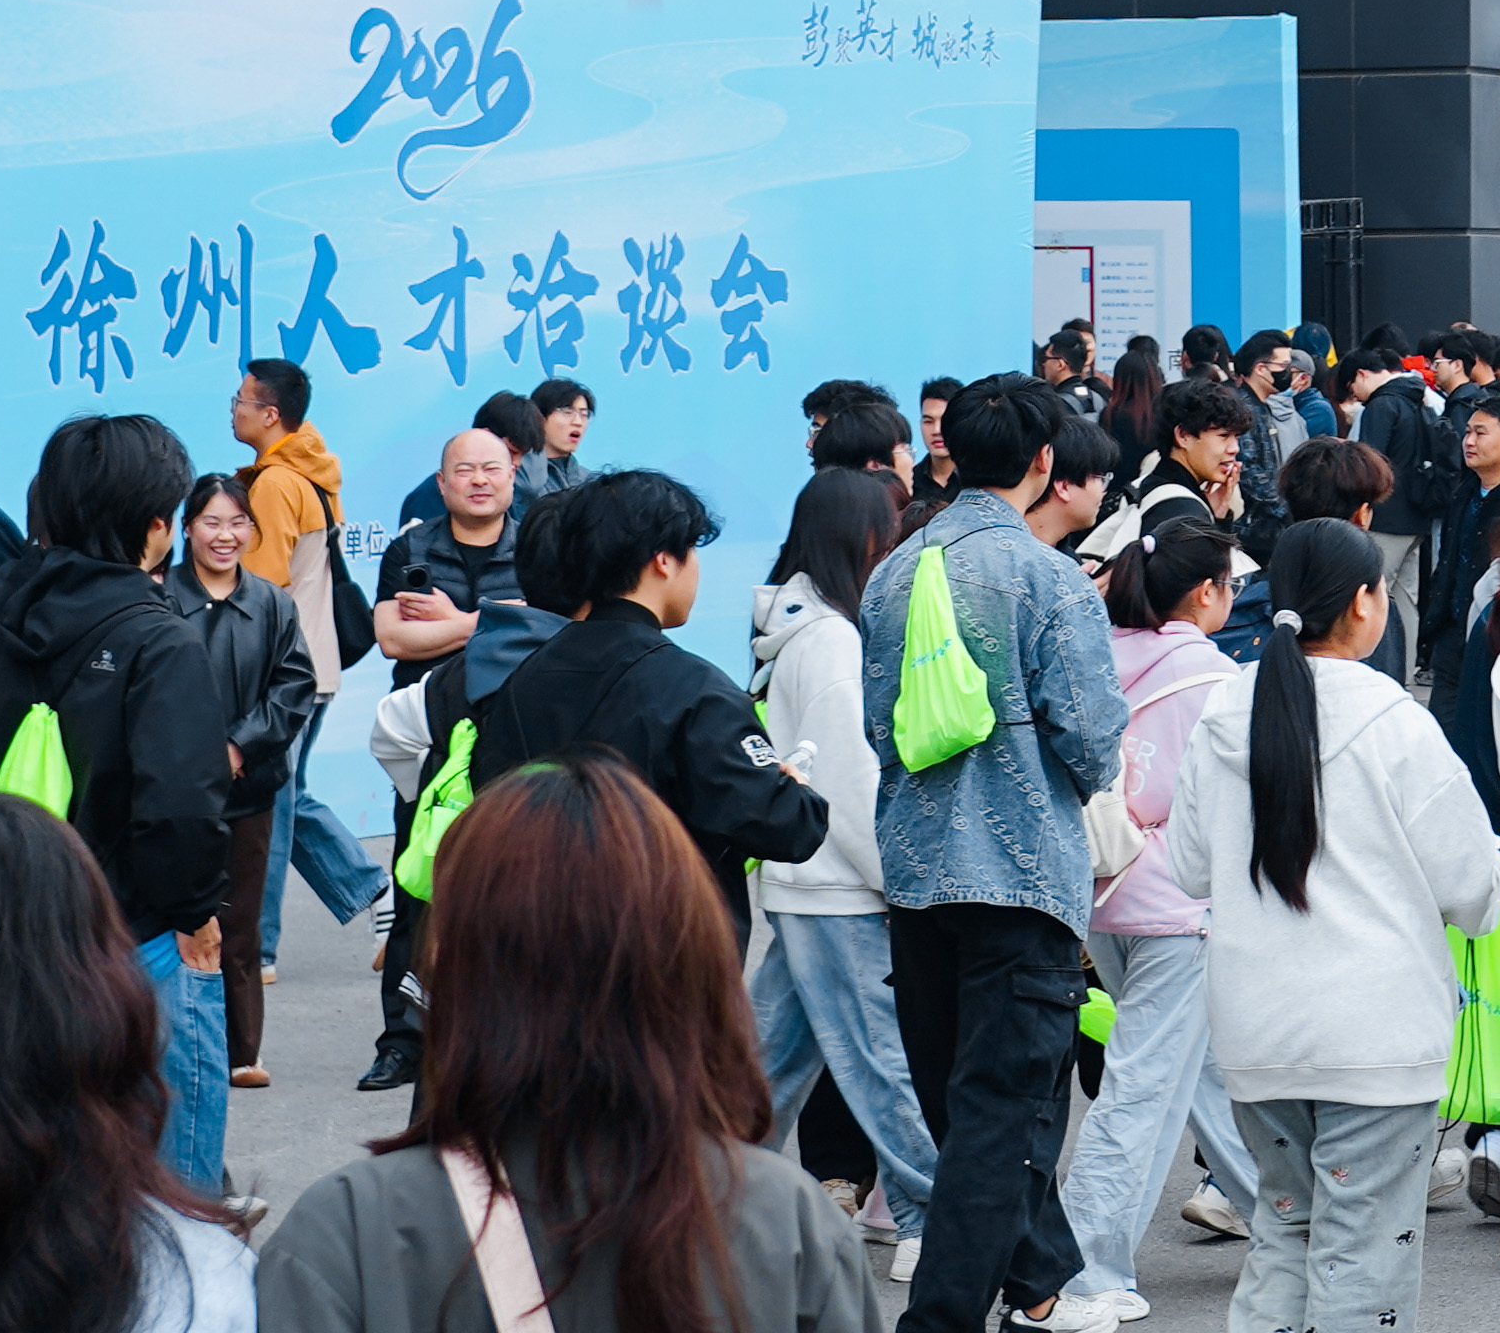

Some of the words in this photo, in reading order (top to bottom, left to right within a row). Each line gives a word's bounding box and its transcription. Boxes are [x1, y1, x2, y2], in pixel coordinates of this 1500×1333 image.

[25, 219, 790, 395] 徐州人才洽谈会
